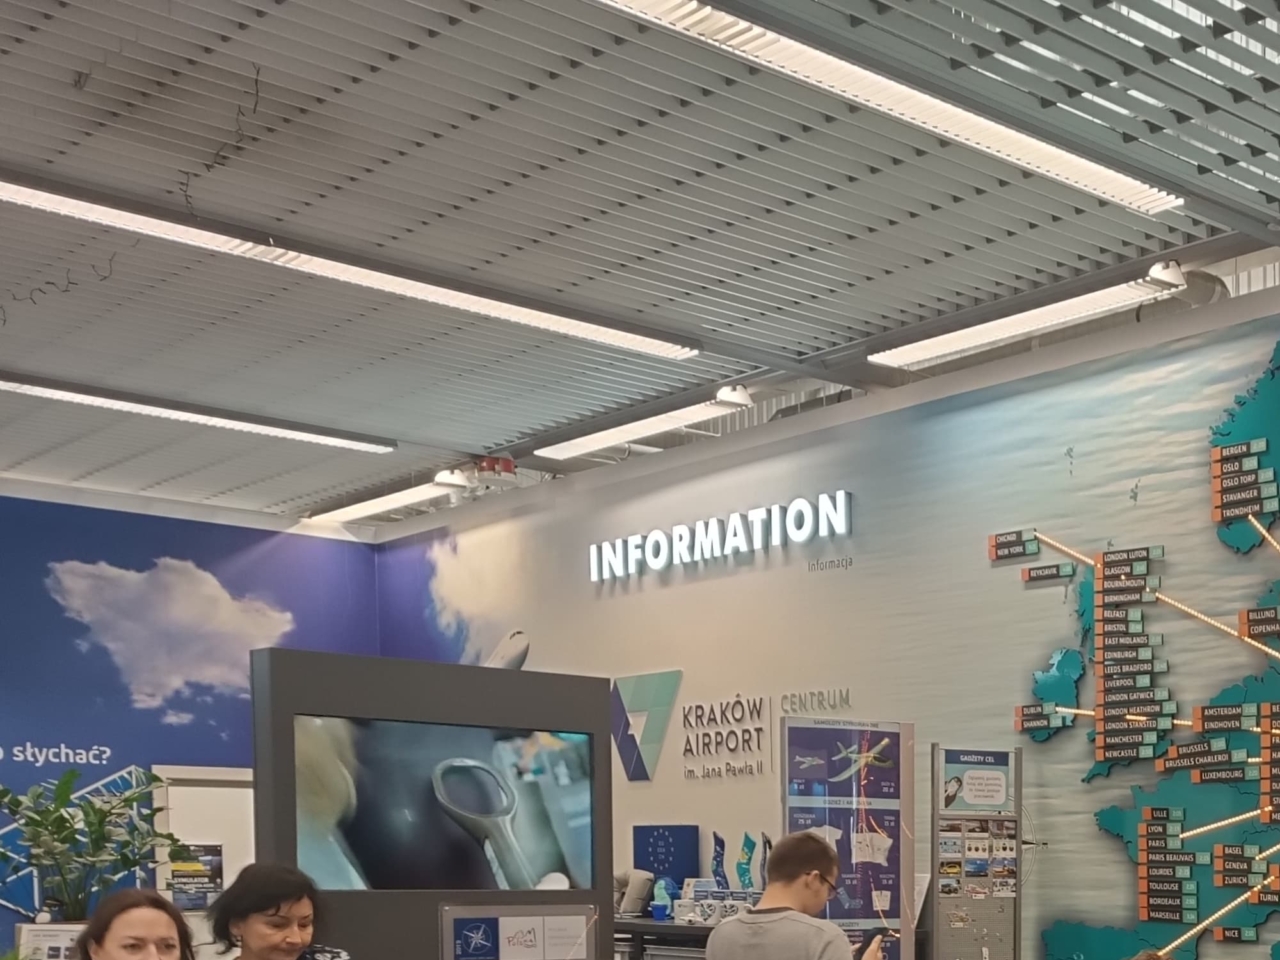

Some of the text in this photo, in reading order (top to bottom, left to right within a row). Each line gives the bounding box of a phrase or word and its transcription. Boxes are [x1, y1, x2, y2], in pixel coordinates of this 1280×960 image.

[1222, 445, 1247, 456] BERGEN
[1222, 462, 1239, 472] OSLO
[1223, 474, 1256, 488] OSLO TORP
[1223, 489, 1258, 503] STAVANGER
[1223, 504, 1260, 518] TRONDHEIM
[590, 489, 848, 582] INFORMATION
[997, 533, 1016, 544] CHICAGO
[997, 545, 1024, 556] NEW YORK
[1104, 550, 1147, 562] LONDON LUTON
[808, 556, 853, 574] Informacja
[1030, 568, 1057, 577] REYKJAVIK
[1104, 565, 1131, 575] GLASGOW
[1104, 579, 1145, 588] BOURNEMOUTH
[1105, 593, 1140, 602] BIRMINGHAM
[1104, 610, 1126, 619] BELFAST
[1249, 610, 1275, 619] BILLUND
[1104, 624, 1126, 632] BRISTOL
[1105, 637, 1119, 645] EAST
[1104, 651, 1136, 659] EDINBURGH
[1122, 663, 1152, 672] BRADFORD
[1105, 679, 1134, 687] LIVERPOOL
[781, 688, 852, 714] CENTRUM
[1105, 691, 1154, 702] LONDON GATWICK
[682, 693, 763, 728] KRAKÓW
[1023, 706, 1042, 715] DUBLIN
[1105, 705, 1160, 716] LONDON HEATHROW
[1204, 707, 1242, 717] AMSTERDAM
[1023, 719, 1048, 728] SHANNON
[1105, 720, 1157, 729] LONDON STANSTED
[1204, 720, 1240, 729] EINDHOVEN
[682, 728, 763, 758] AIRPORT
[1106, 735, 1142, 744] MANCHESTER
[1178, 743, 1208, 754] BRUSSELS
[12, 742, 111, 767] słychać?
[1105, 749, 1137, 758] NEWCASTLE
[1165, 754, 1229, 769] BRUSSELS CHARLEROI
[684, 760, 764, 780] im. Jana Pawła II
[1202, 770, 1243, 780] LUXEMBOURG
[1153, 810, 1167, 818] LILLE
[1148, 825, 1163, 834] LYON
[1148, 839, 1165, 848] PARIS
[1224, 847, 1242, 855] BASEL
[1148, 853, 1194, 862] PARIS BEAUVAIS
[1225, 861, 1248, 870] GENEVA
[1149, 867, 1173, 876] LOURDES
[1224, 876, 1247, 885] ZURICH
[1149, 882, 1179, 891] TOULOUSE
[1149, 897, 1181, 906] BORDEAUX
[1260, 893, 1279, 903] TURIN
[1150, 911, 1180, 920] MARSEILLE
[1225, 930, 1239, 938] NICE
